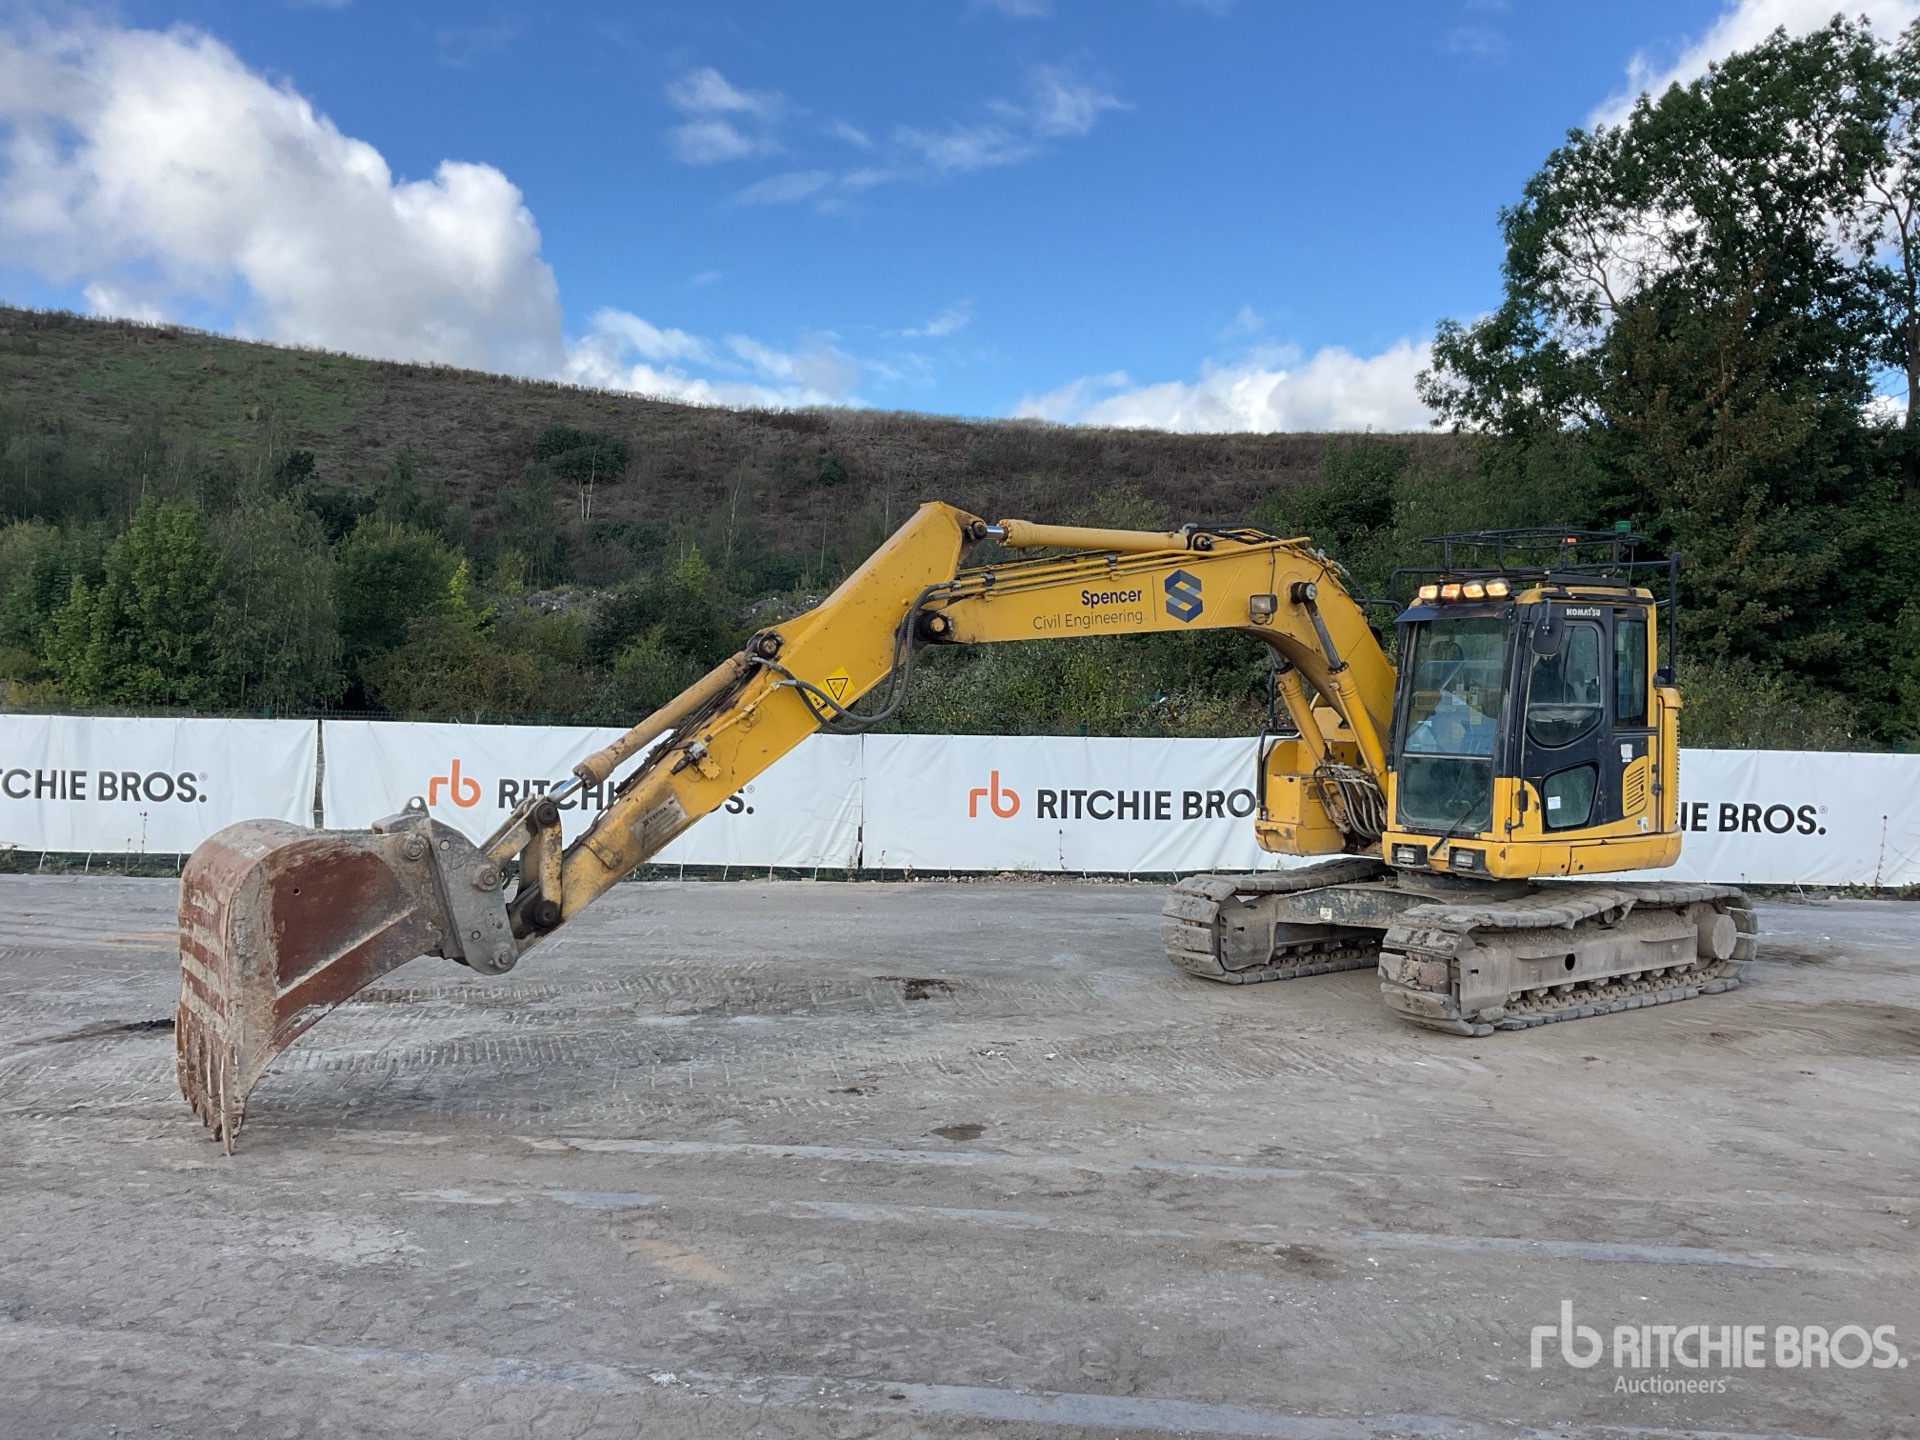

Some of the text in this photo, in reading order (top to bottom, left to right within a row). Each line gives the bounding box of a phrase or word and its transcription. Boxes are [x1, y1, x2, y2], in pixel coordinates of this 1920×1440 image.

[1081, 589, 1142, 608] Spencer
[1033, 609, 1143, 630] Civil Engineering
[1566, 606, 1601, 617] KOMATSU
[0, 768, 87, 800] CHIE
[1037, 788, 1257, 821] RITCHIE BRO
